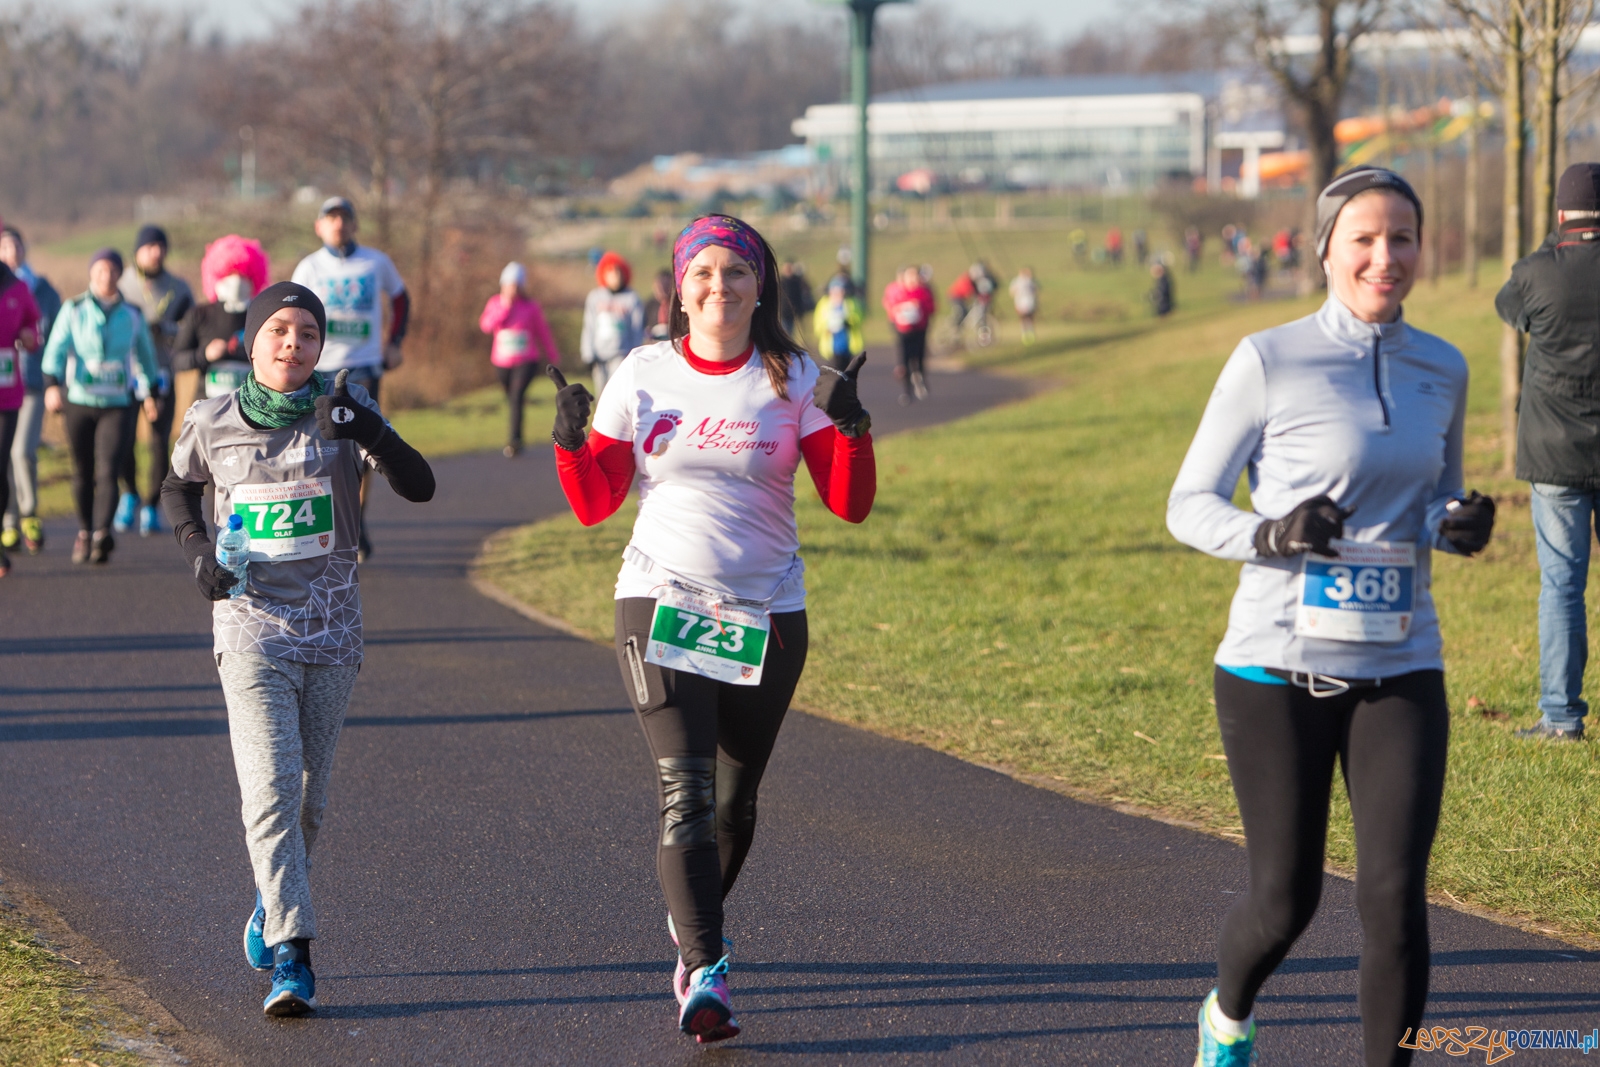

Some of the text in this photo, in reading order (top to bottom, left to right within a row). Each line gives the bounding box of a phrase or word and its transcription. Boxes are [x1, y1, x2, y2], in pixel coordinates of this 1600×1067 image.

[686, 416, 760, 439] Mamy
[697, 433, 779, 456] Biegamy
[222, 455, 238, 467] 4F
[258, 487, 274, 495] BIEG
[248, 499, 316, 531] 724
[274, 530, 293, 538] OLAF
[1324, 565, 1401, 603] 368
[676, 610, 745, 653] 723
[694, 644, 718, 655] ANNA
